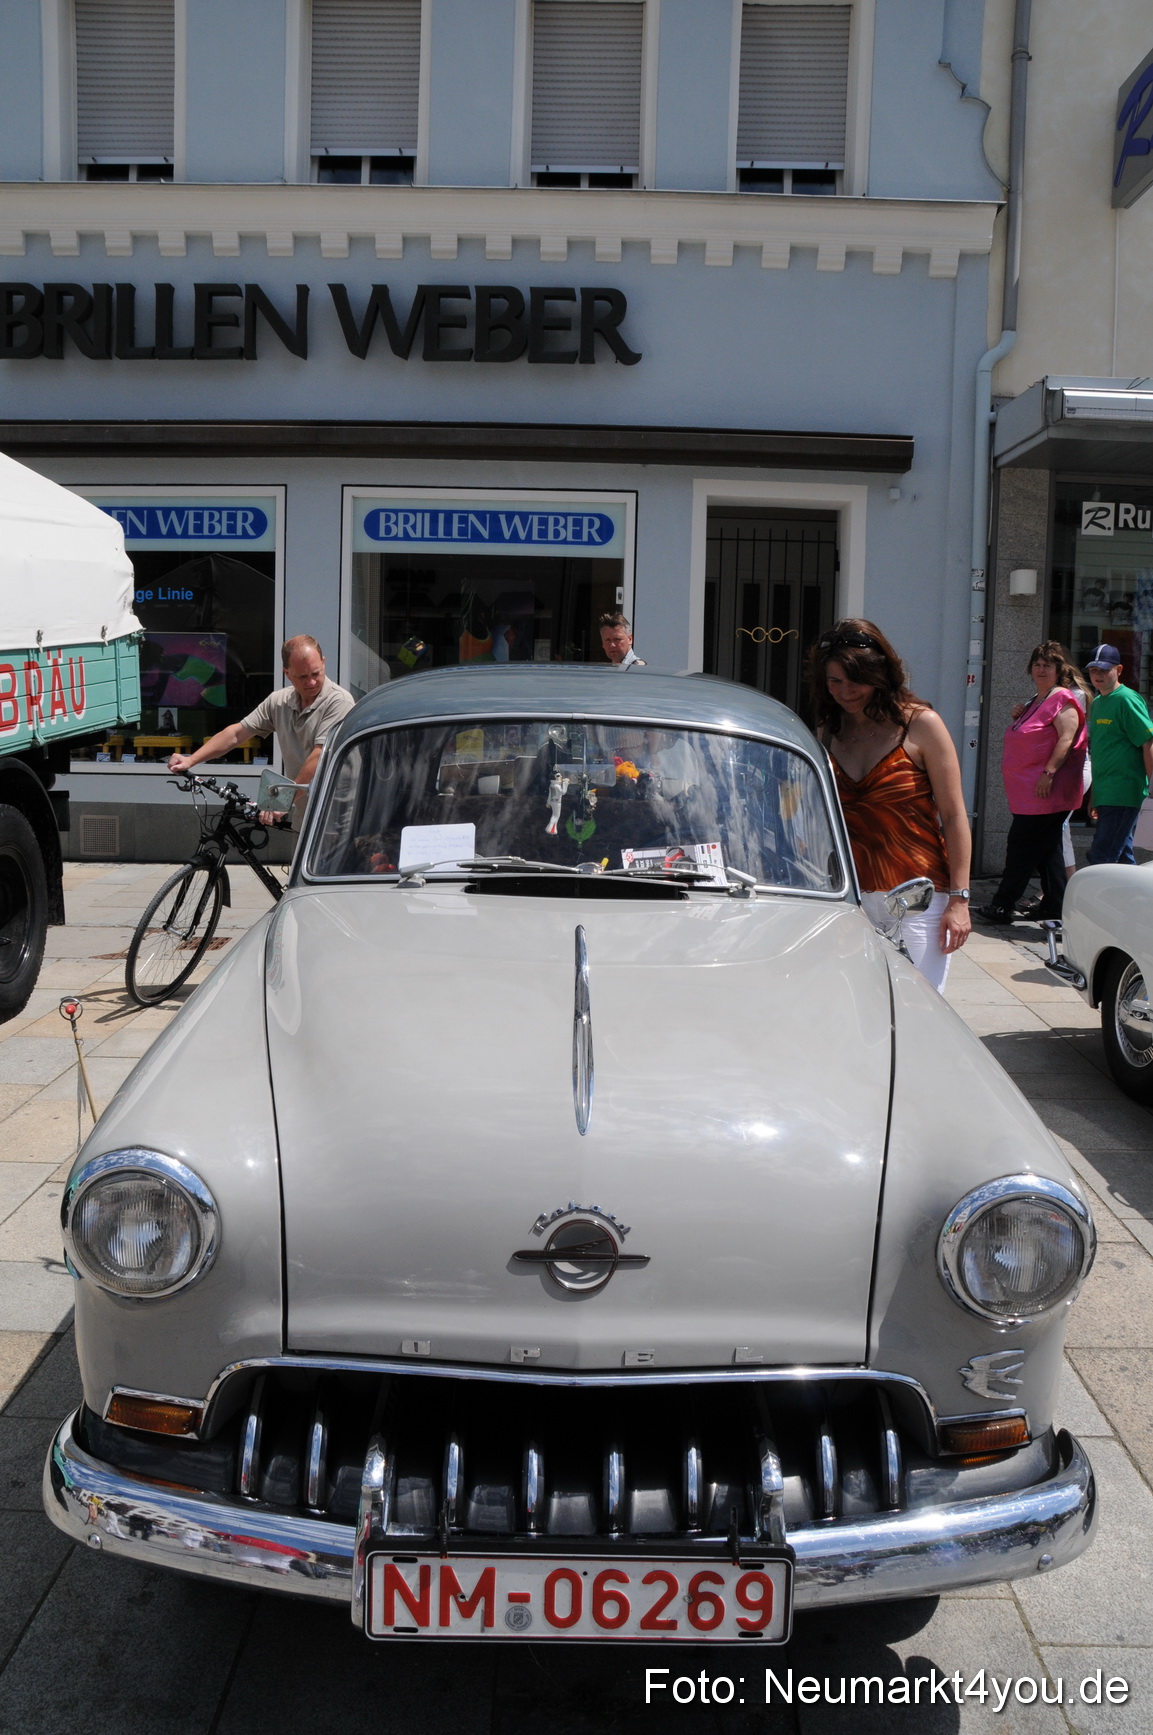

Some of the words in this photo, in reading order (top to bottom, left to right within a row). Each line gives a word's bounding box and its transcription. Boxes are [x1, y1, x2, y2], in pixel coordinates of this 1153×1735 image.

[0, 282, 310, 360] BRILLEN
[327, 283, 642, 365] WEBER
[155, 510, 256, 536] WEBER
[378, 511, 490, 539] BRILLEN
[498, 513, 603, 542] WEBER
[1118, 502, 1153, 530] Ru
[134, 589, 153, 603] ge
[158, 587, 194, 600] Linie
[0, 648, 86, 738] BRÄU
